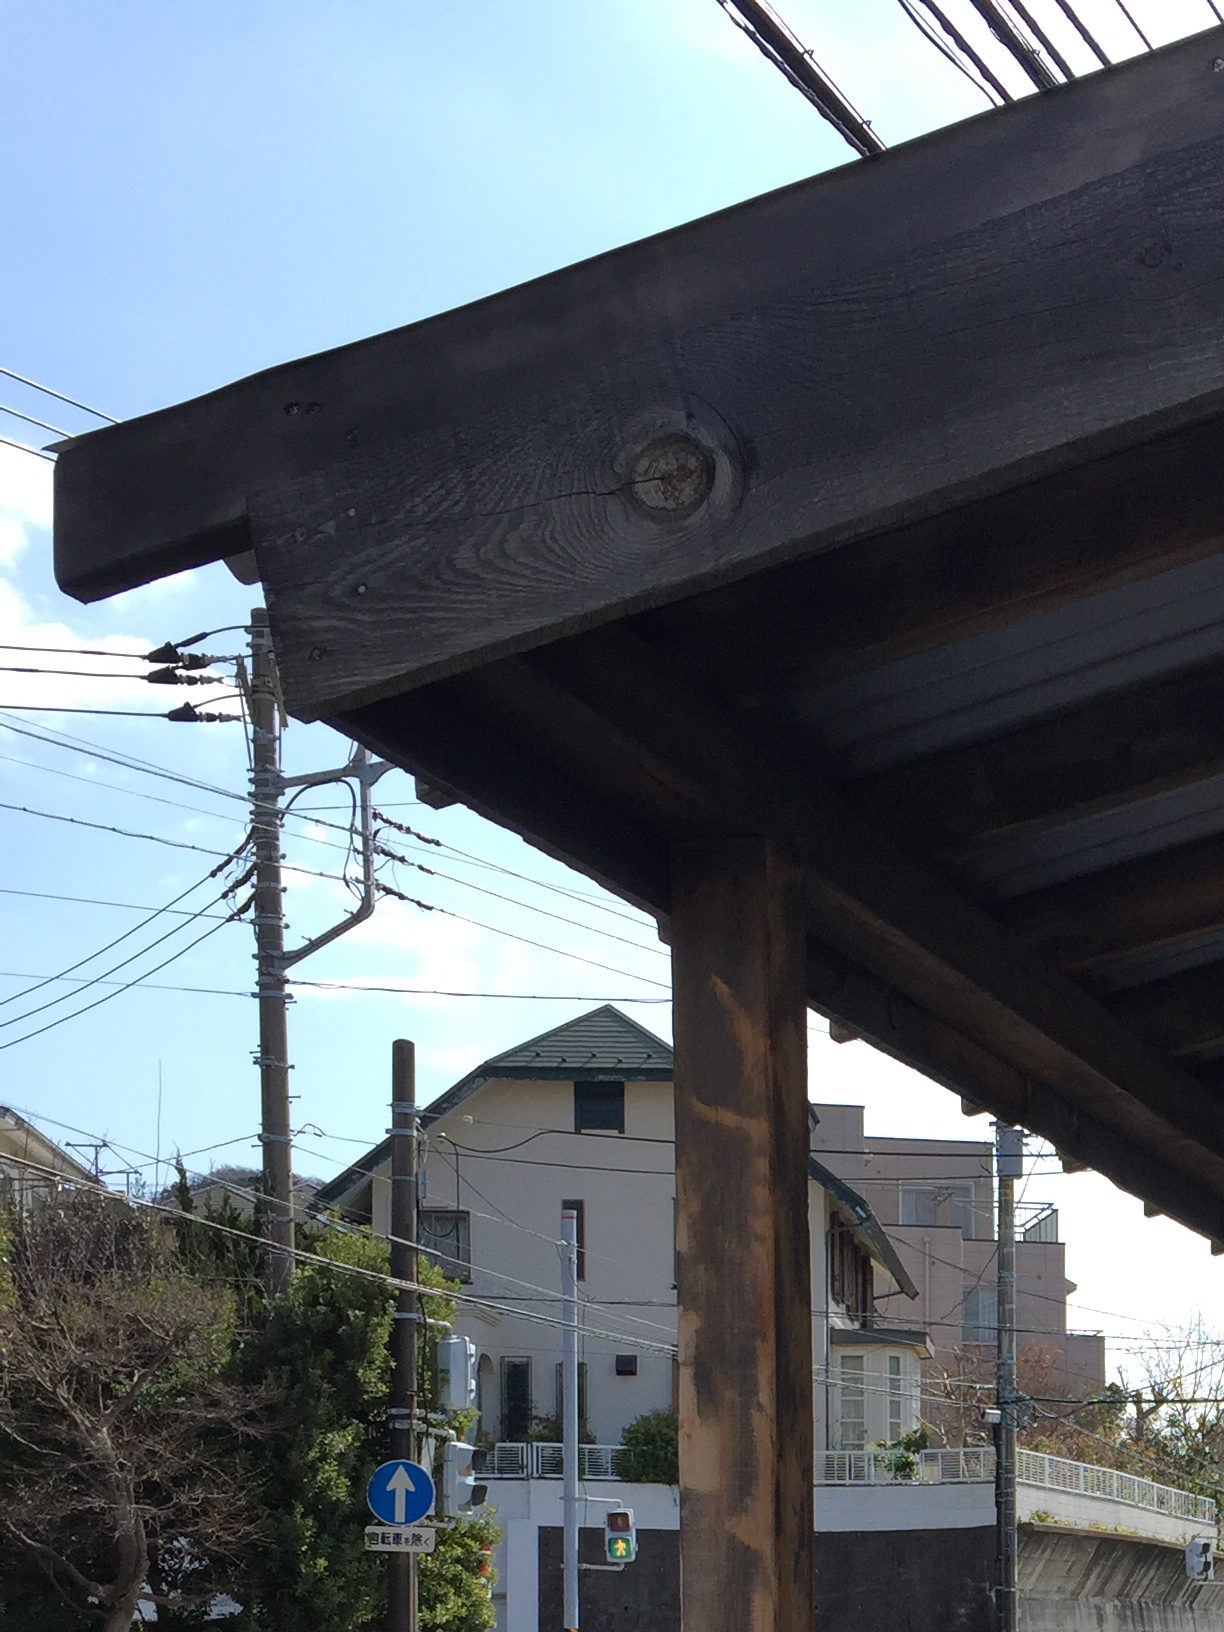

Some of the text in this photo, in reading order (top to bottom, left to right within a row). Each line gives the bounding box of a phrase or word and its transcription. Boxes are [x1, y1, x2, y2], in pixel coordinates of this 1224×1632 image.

[367, 1532, 430, 1547] 自転車を除く
